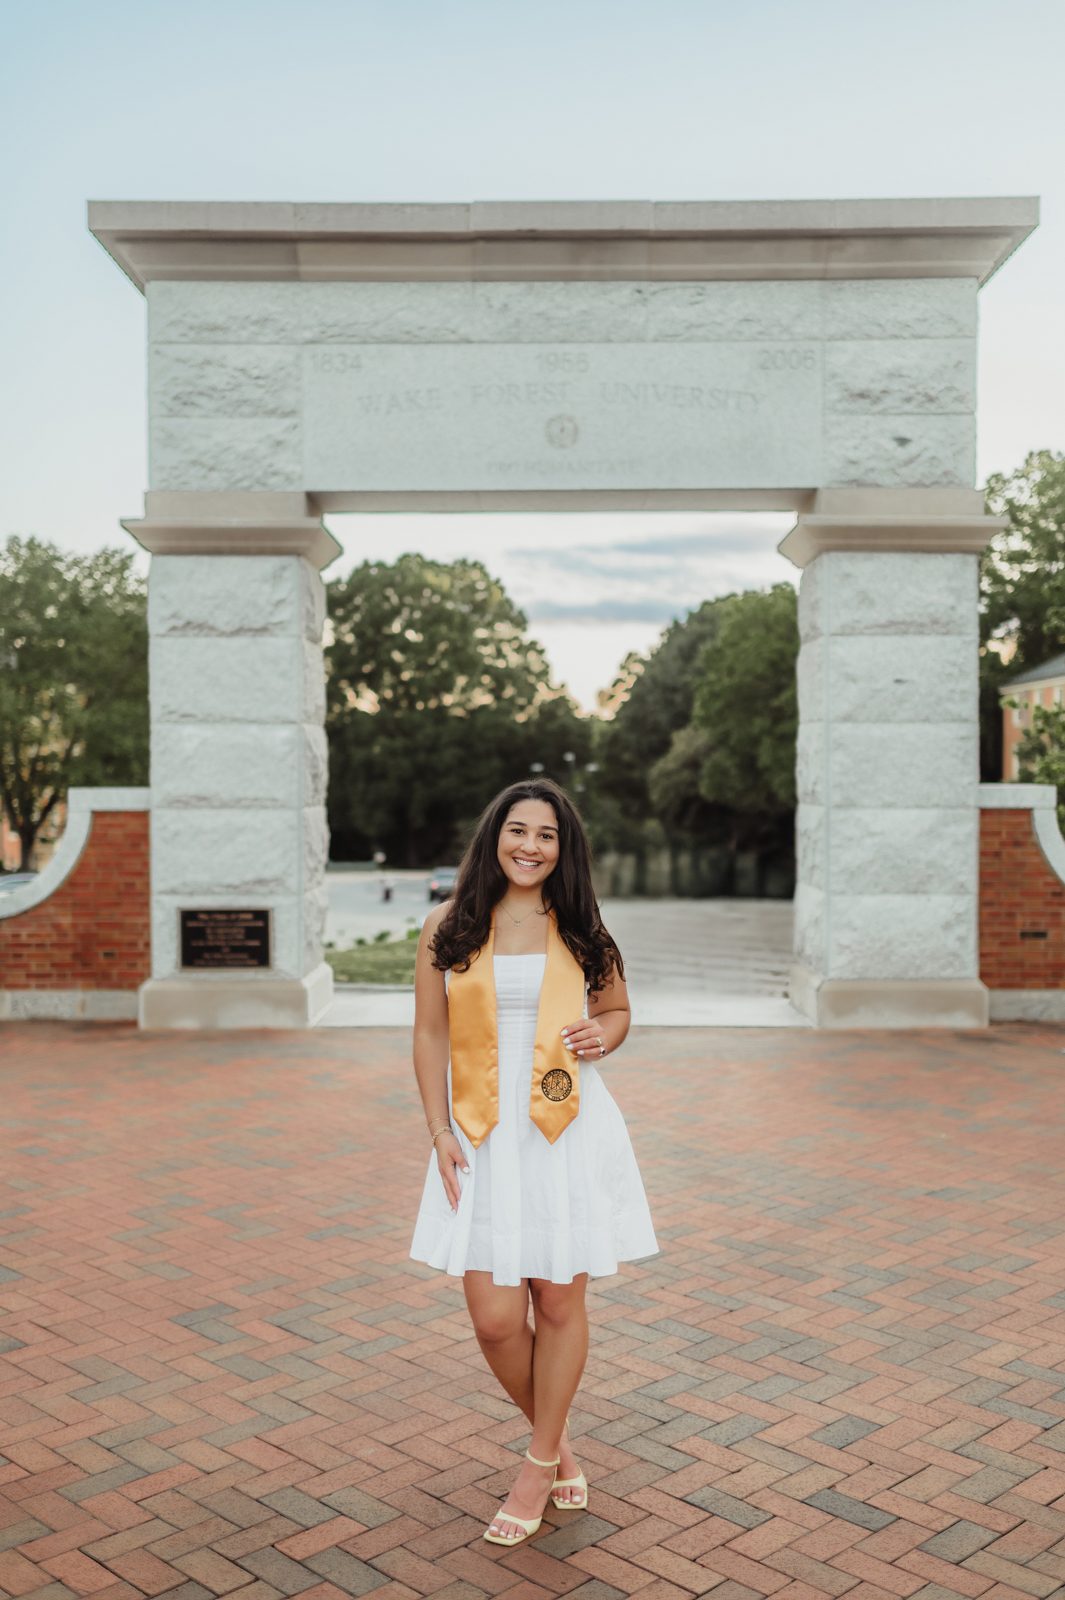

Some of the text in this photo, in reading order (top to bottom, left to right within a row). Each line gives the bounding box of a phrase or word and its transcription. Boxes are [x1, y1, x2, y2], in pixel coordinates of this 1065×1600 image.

[311, 352, 363, 374] 1834
[757, 348, 817, 371] 2006
[356, 381, 768, 416] WAKE FOREST UNIVERSITY
